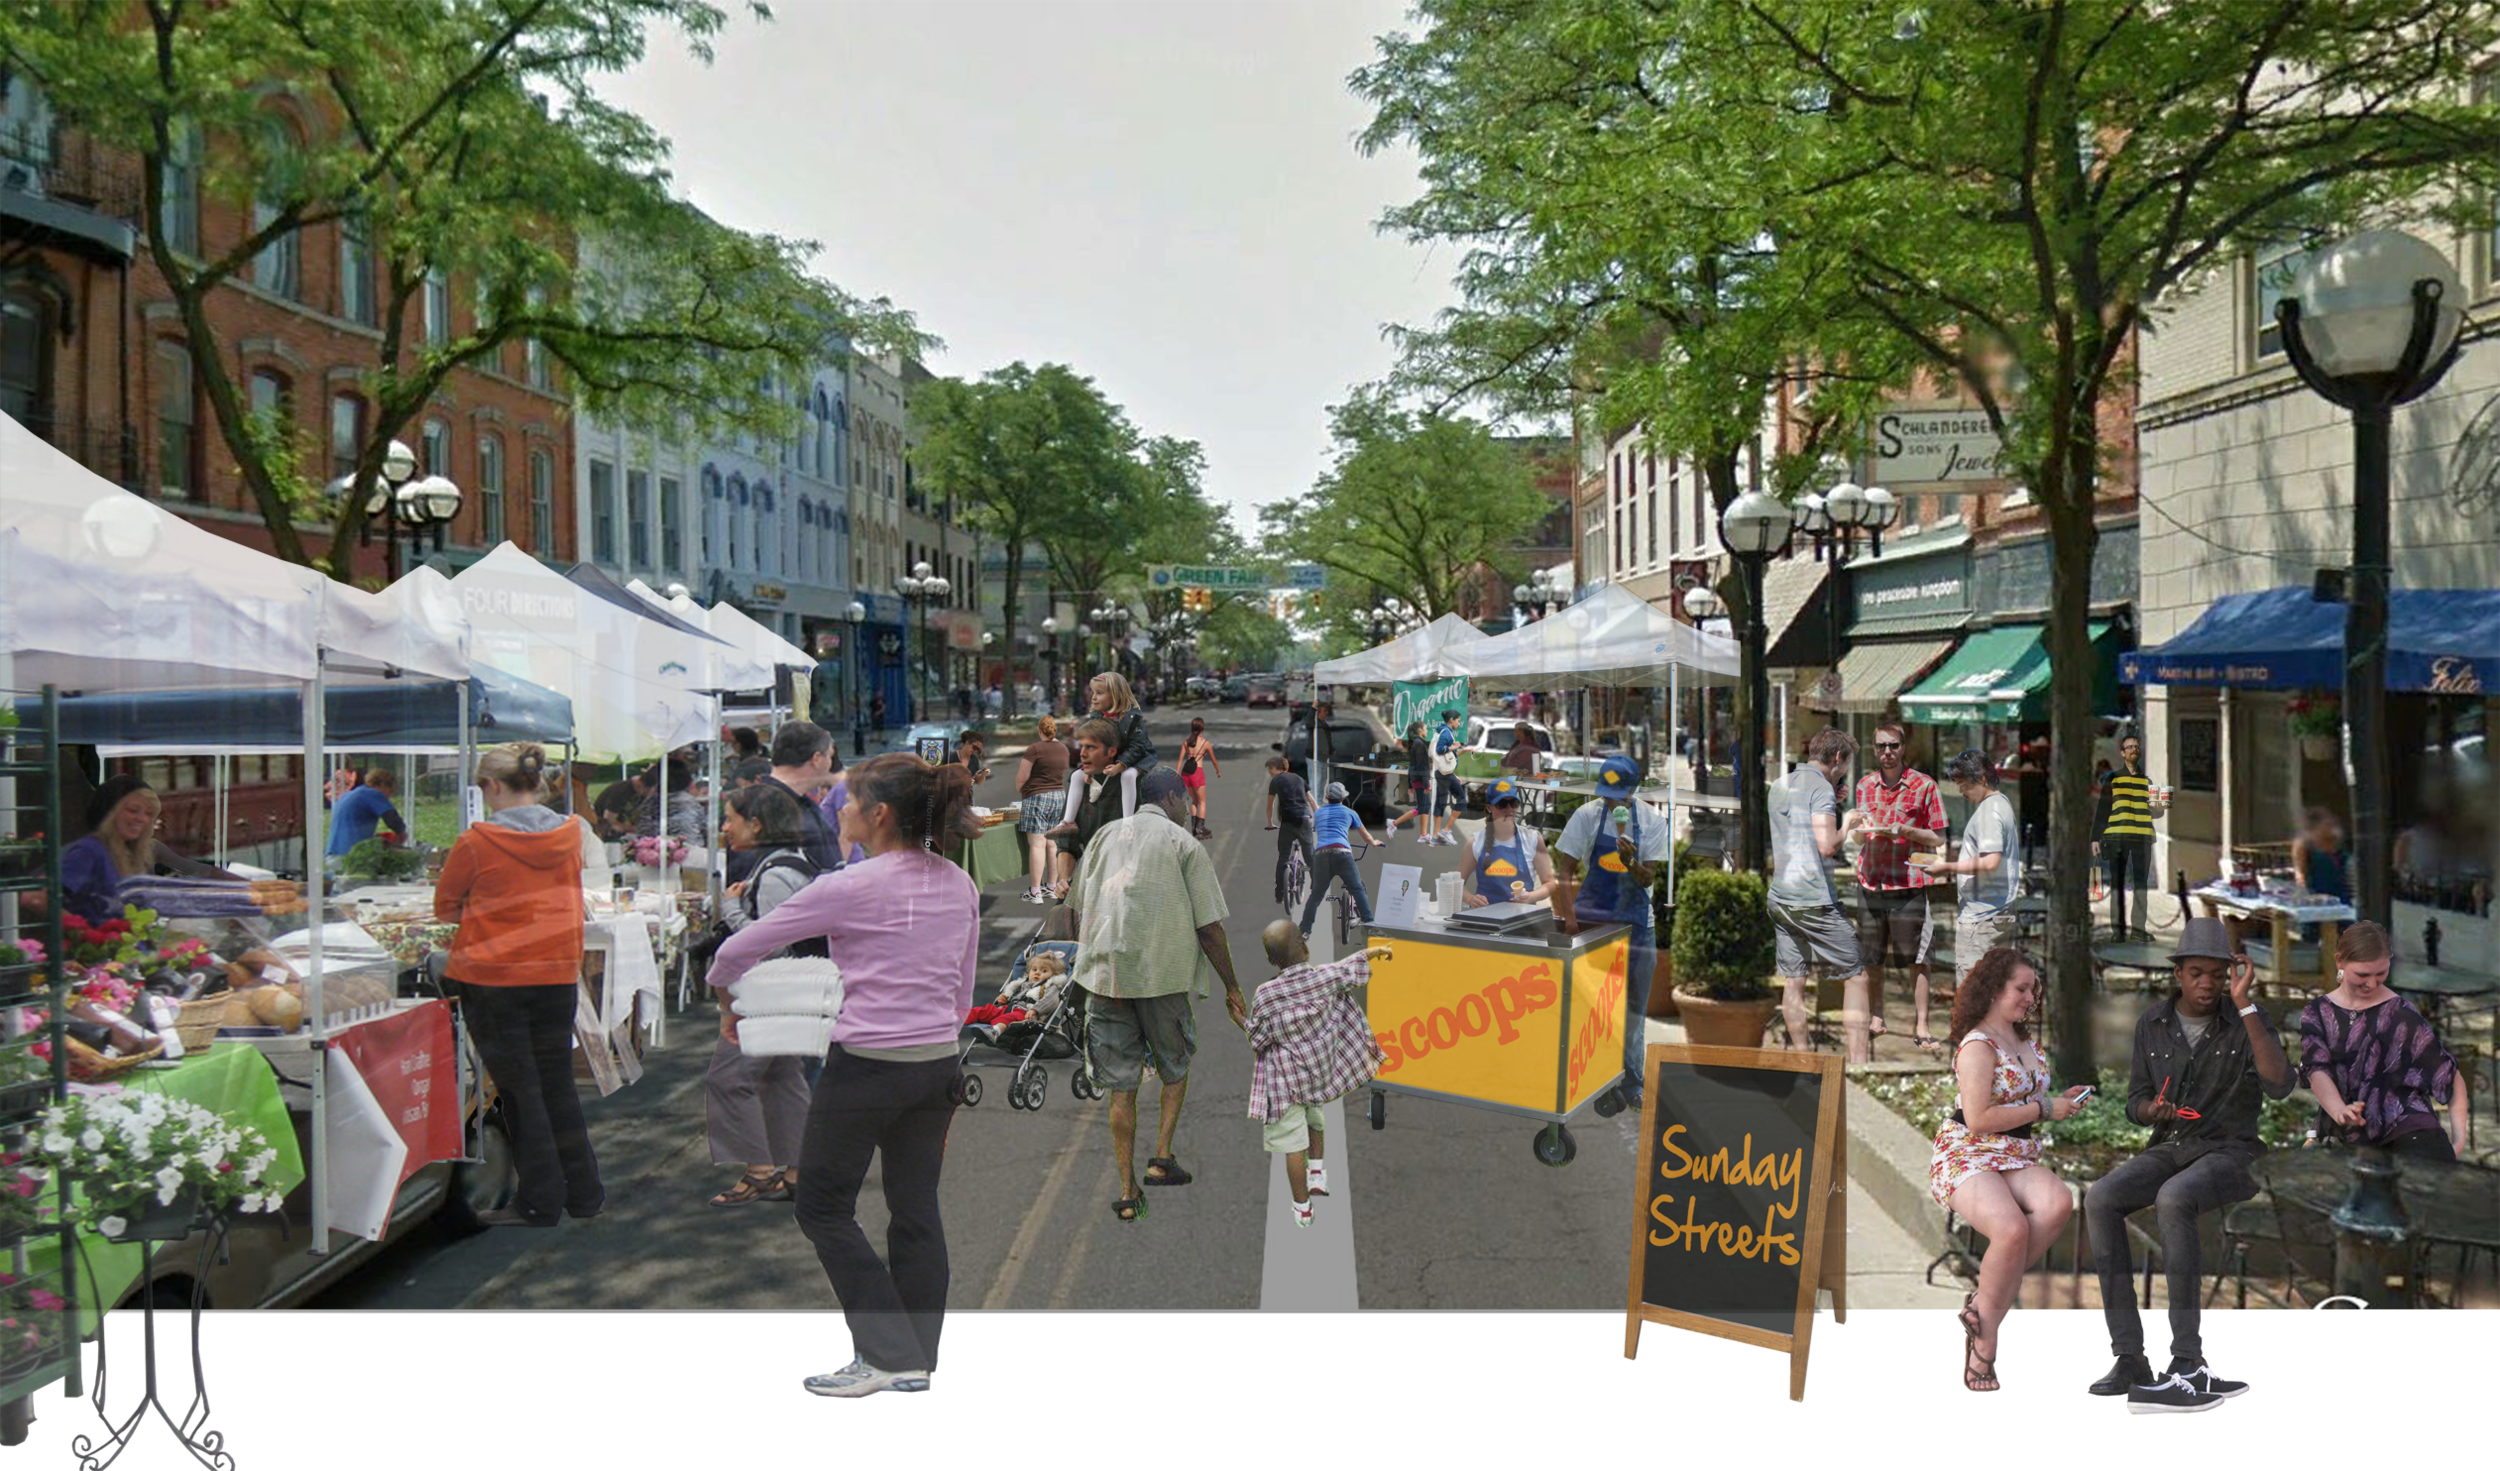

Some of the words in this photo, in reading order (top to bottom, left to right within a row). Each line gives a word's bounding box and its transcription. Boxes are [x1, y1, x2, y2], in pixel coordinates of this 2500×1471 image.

[463, 586, 509, 615] FOUR
[510, 590, 576, 620] DIRECTIONS
[1174, 566, 1224, 584] GREEN
[1393, 677, 1464, 740] Organic
[921, 784, 941, 792] Market
[924, 794, 935, 853] Information
[922, 857, 932, 893] Center
[1486, 866, 1516, 876] scoops
[1374, 962, 1558, 1076] scoops
[1569, 941, 1625, 1104] scoops
[1661, 1124, 1802, 1219] Sunday
[1649, 1194, 1800, 1266] Streets
